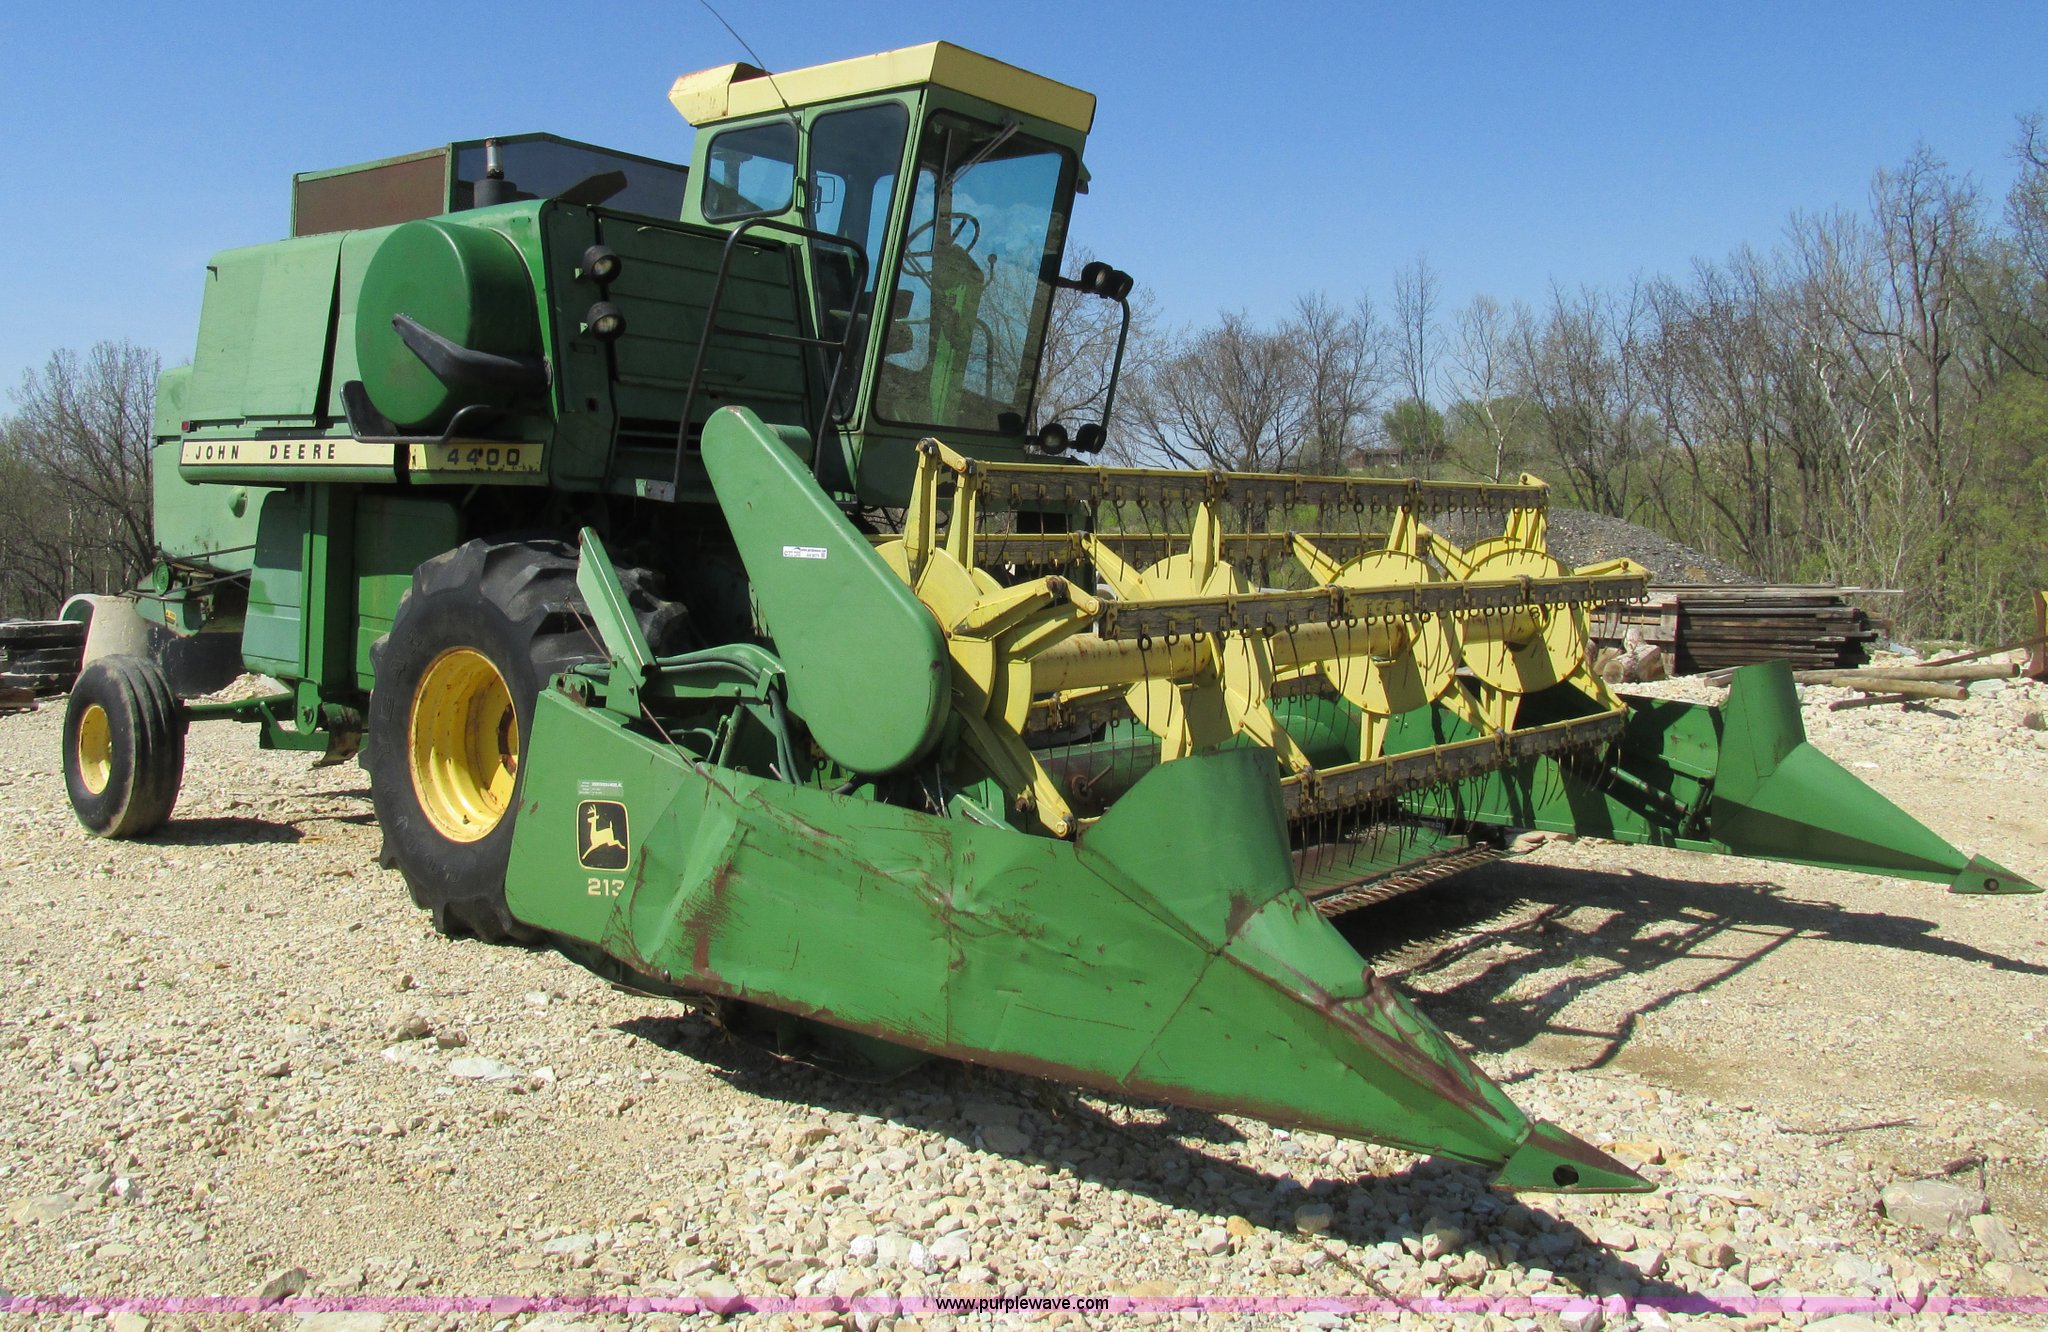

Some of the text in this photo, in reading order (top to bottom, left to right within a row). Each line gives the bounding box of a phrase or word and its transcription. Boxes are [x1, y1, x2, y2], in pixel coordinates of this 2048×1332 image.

[195, 444, 335, 460] JOHN DEERE
[447, 447, 521, 466] 4400
[587, 878, 625, 897] 213
